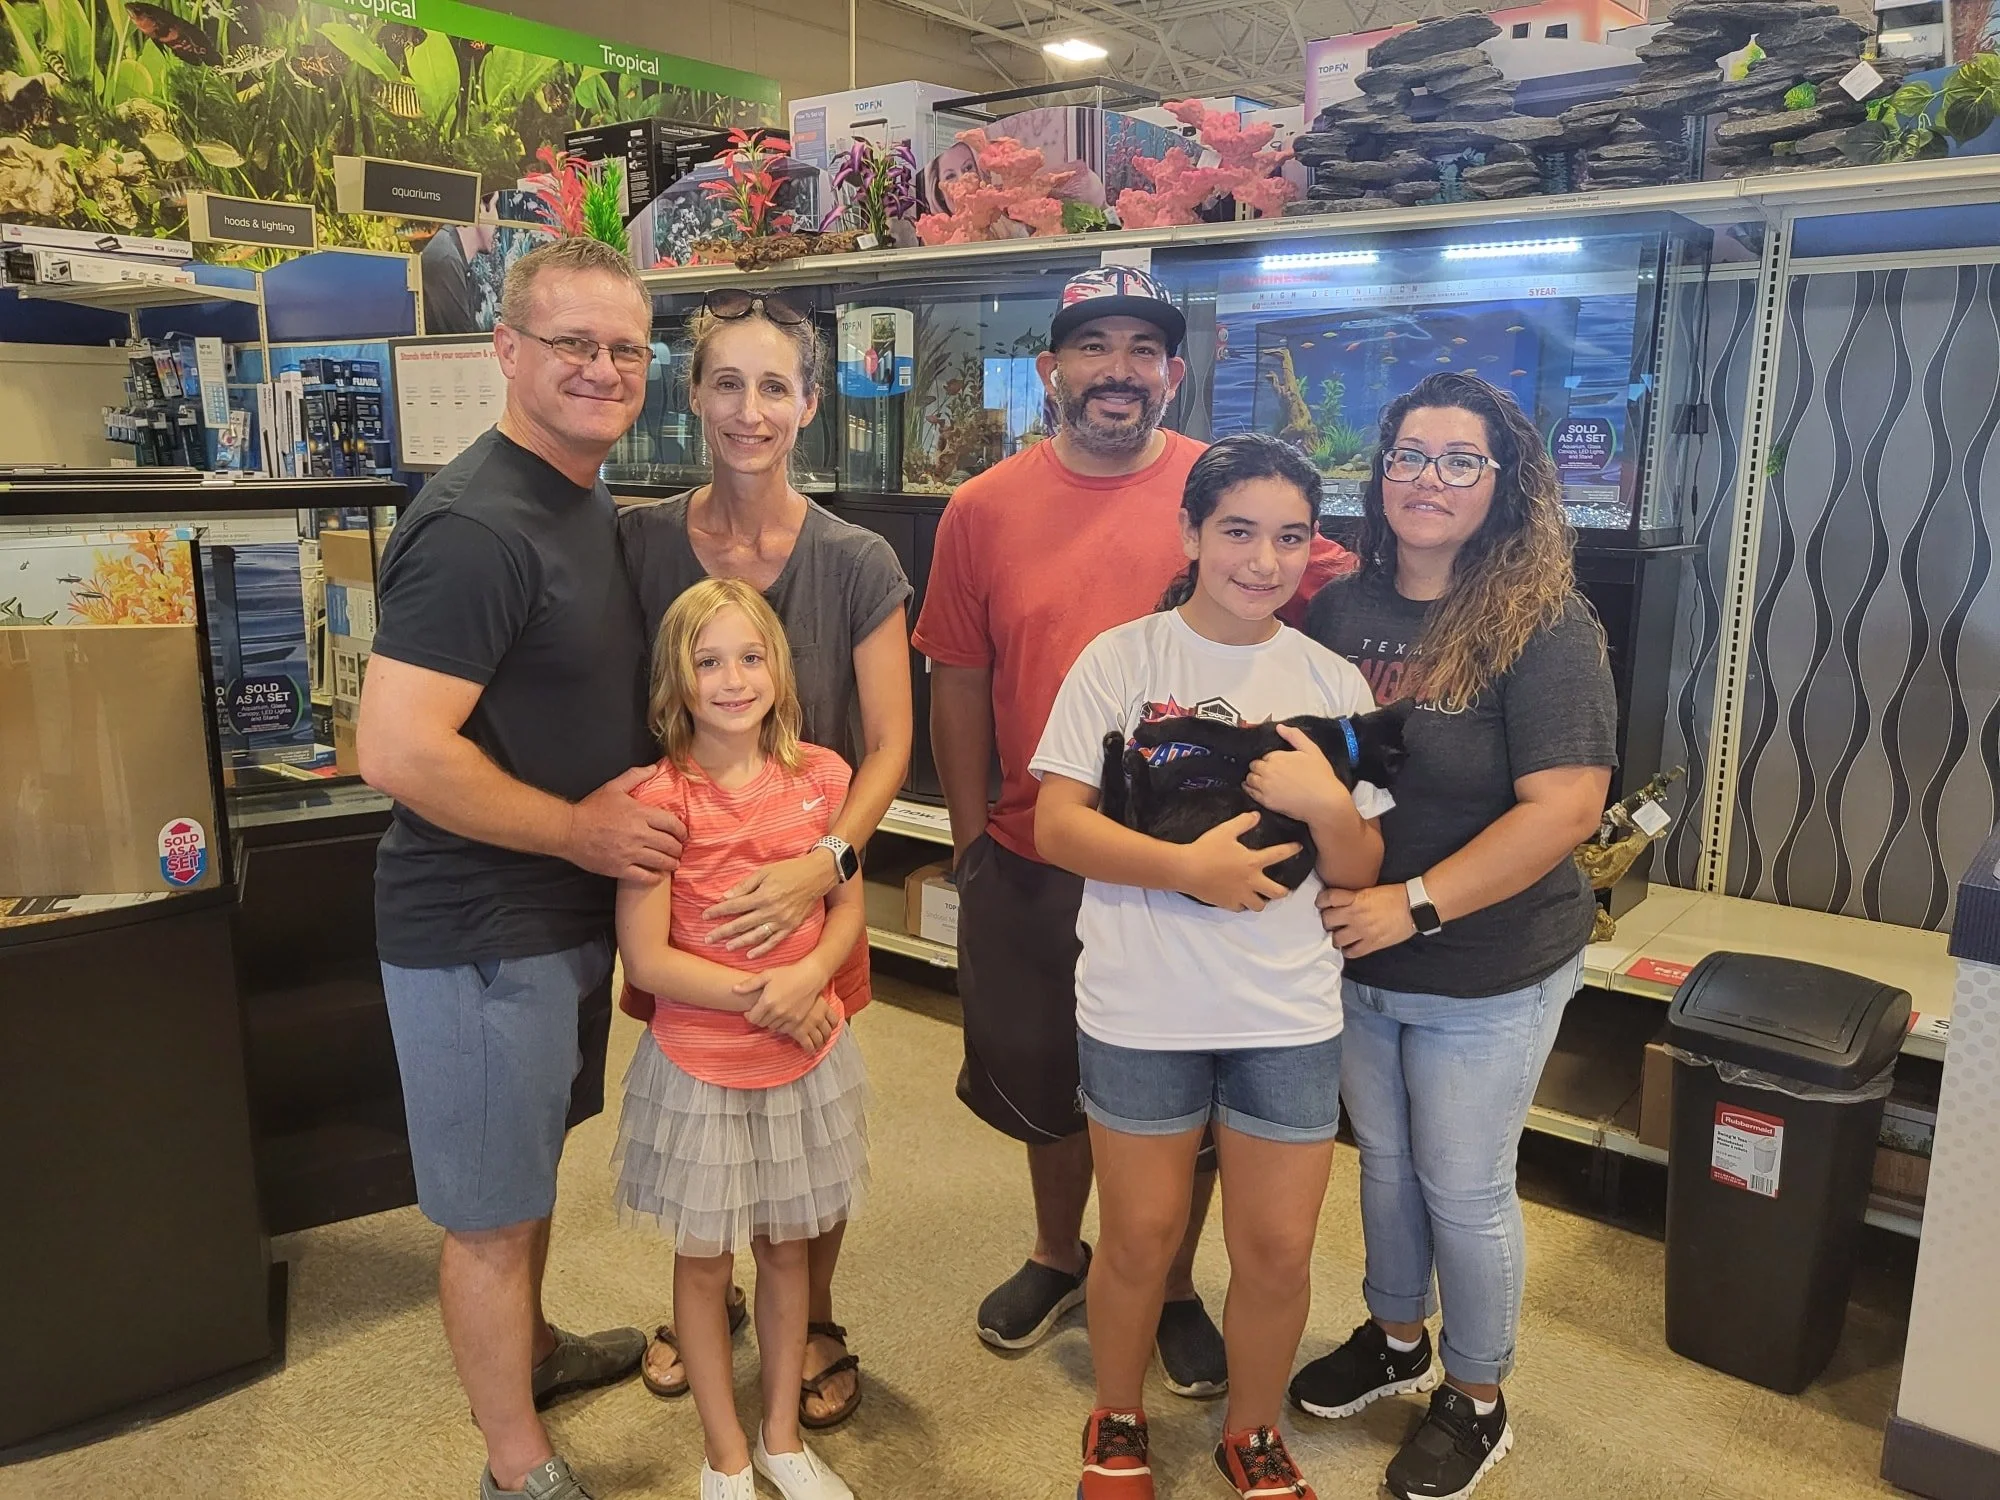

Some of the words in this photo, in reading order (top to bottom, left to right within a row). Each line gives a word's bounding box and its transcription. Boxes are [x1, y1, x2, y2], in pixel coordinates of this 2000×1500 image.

[345, 0, 417, 20] opical
[599, 44, 659, 76] Tropical
[391, 186, 441, 202] aquariums
[224, 215, 250, 229] hoods
[252, 218, 260, 229] &
[262, 218, 295, 234] lighting
[1259, 292, 1297, 300] HIGH
[1311, 285, 1418, 299] DEFINITION
[401, 352, 419, 361] Stands
[420, 351, 433, 360] that
[433, 350, 441, 360] fit
[441, 352, 453, 362] your
[455, 351, 482, 360] aquarium
[352, 377, 379, 387] FLUVAL
[1567, 425, 1598, 434] SOLD
[1558, 434, 1573, 443] AS
[1575, 434, 1584, 443] A
[1585, 434, 1607, 443] SET
[245, 683, 279, 694] SOLD
[236, 694, 253, 705] AS
[255, 693, 265, 703] A
[267, 691, 291, 702] SET
[164, 833, 199, 848] SOLD
[168, 846, 186, 857] AS
[187, 844, 199, 855] A
[167, 853, 201, 872] SET
[1725, 1116, 1773, 1134] Rubbermaid
